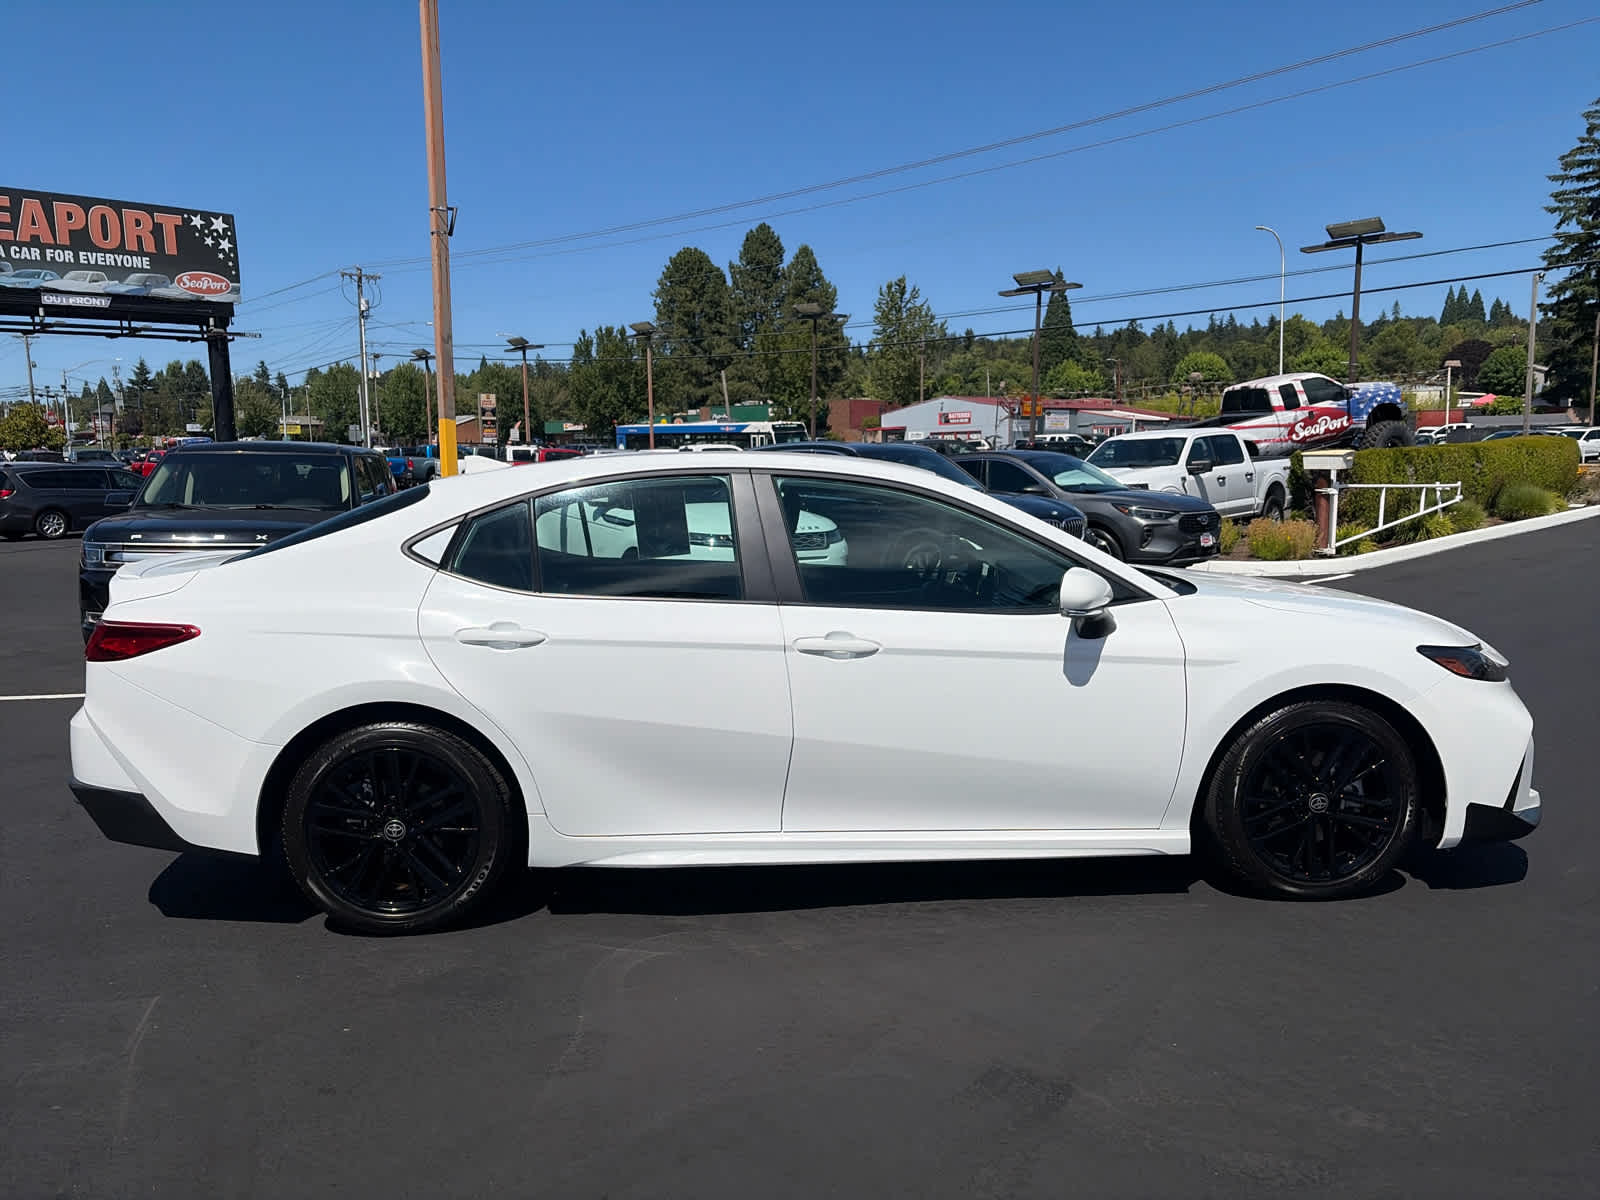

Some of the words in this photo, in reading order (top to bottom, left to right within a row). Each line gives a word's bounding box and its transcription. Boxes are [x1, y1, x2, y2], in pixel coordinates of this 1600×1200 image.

[10, 246, 41, 260] CAR
[45, 248, 74, 264] FOR
[79, 251, 151, 269] EVERYONE
[180, 275, 227, 290] SeaPort
[1292, 415, 1349, 441] SeaPort
